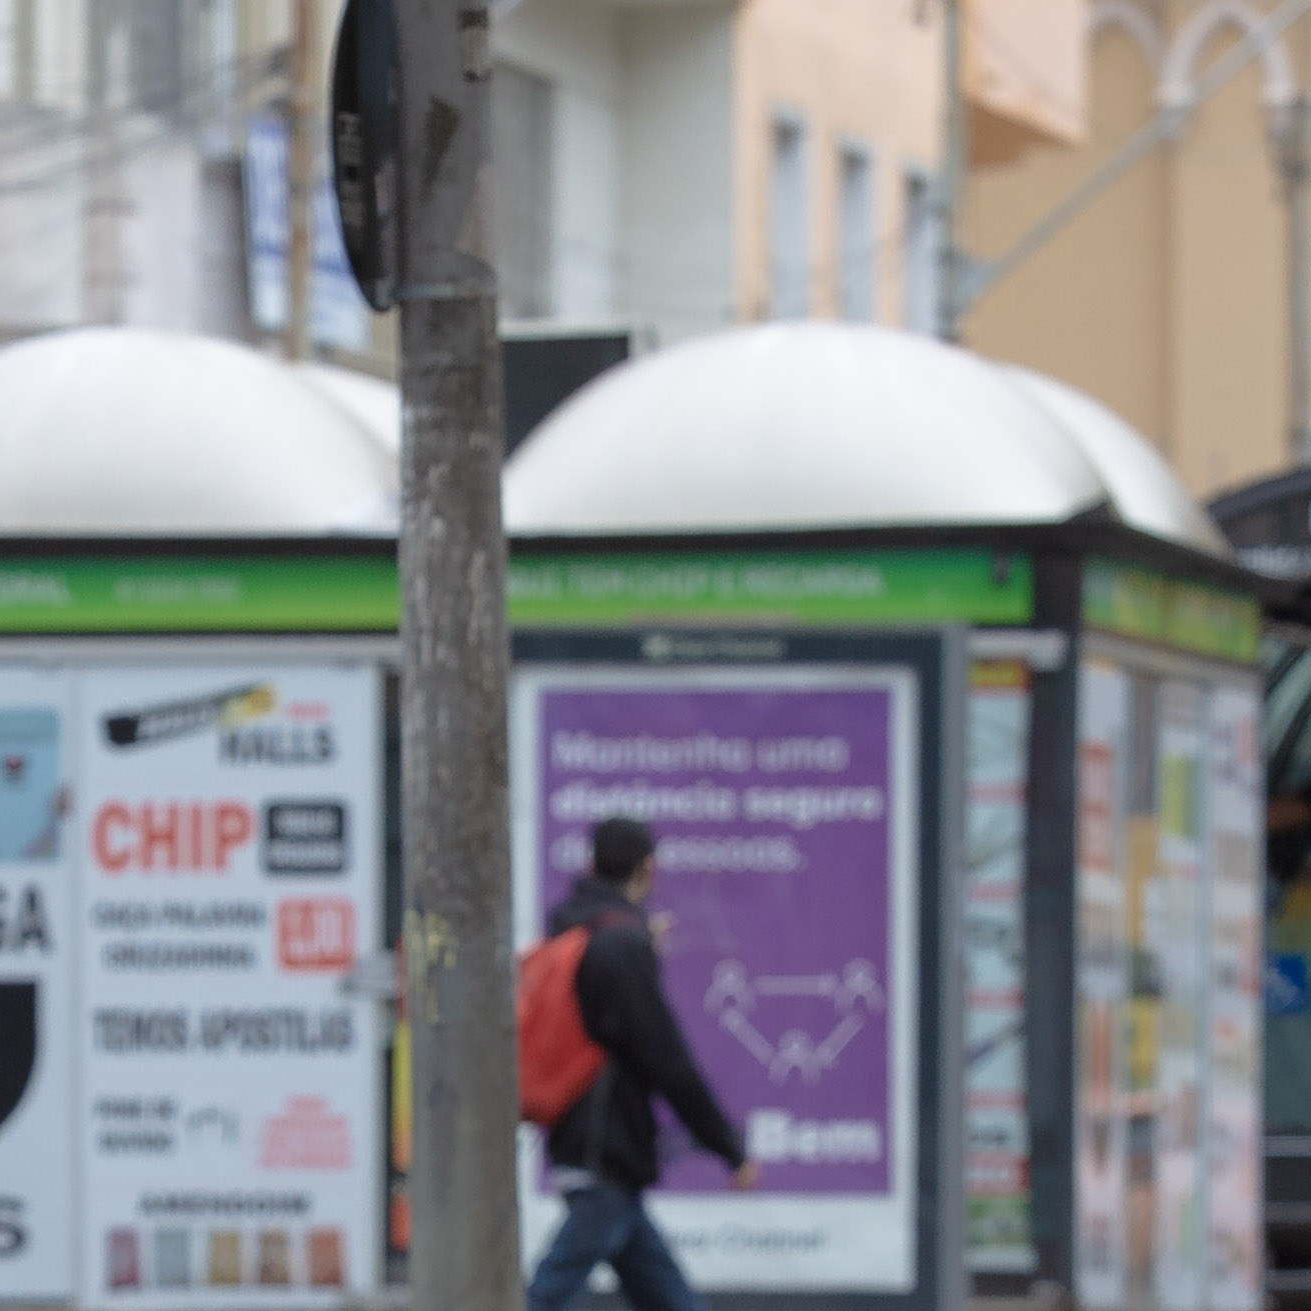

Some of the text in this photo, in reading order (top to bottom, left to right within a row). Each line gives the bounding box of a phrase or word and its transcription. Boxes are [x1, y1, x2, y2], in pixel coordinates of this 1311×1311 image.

[218, 724, 335, 764] HALLS
[549, 730, 850, 772] Mantenha uma
[549, 778, 883, 830] distância segura
[91, 800, 258, 876] CHIP
[655, 834, 804, 873] essoas.
[746, 1111, 881, 1164] Bem
